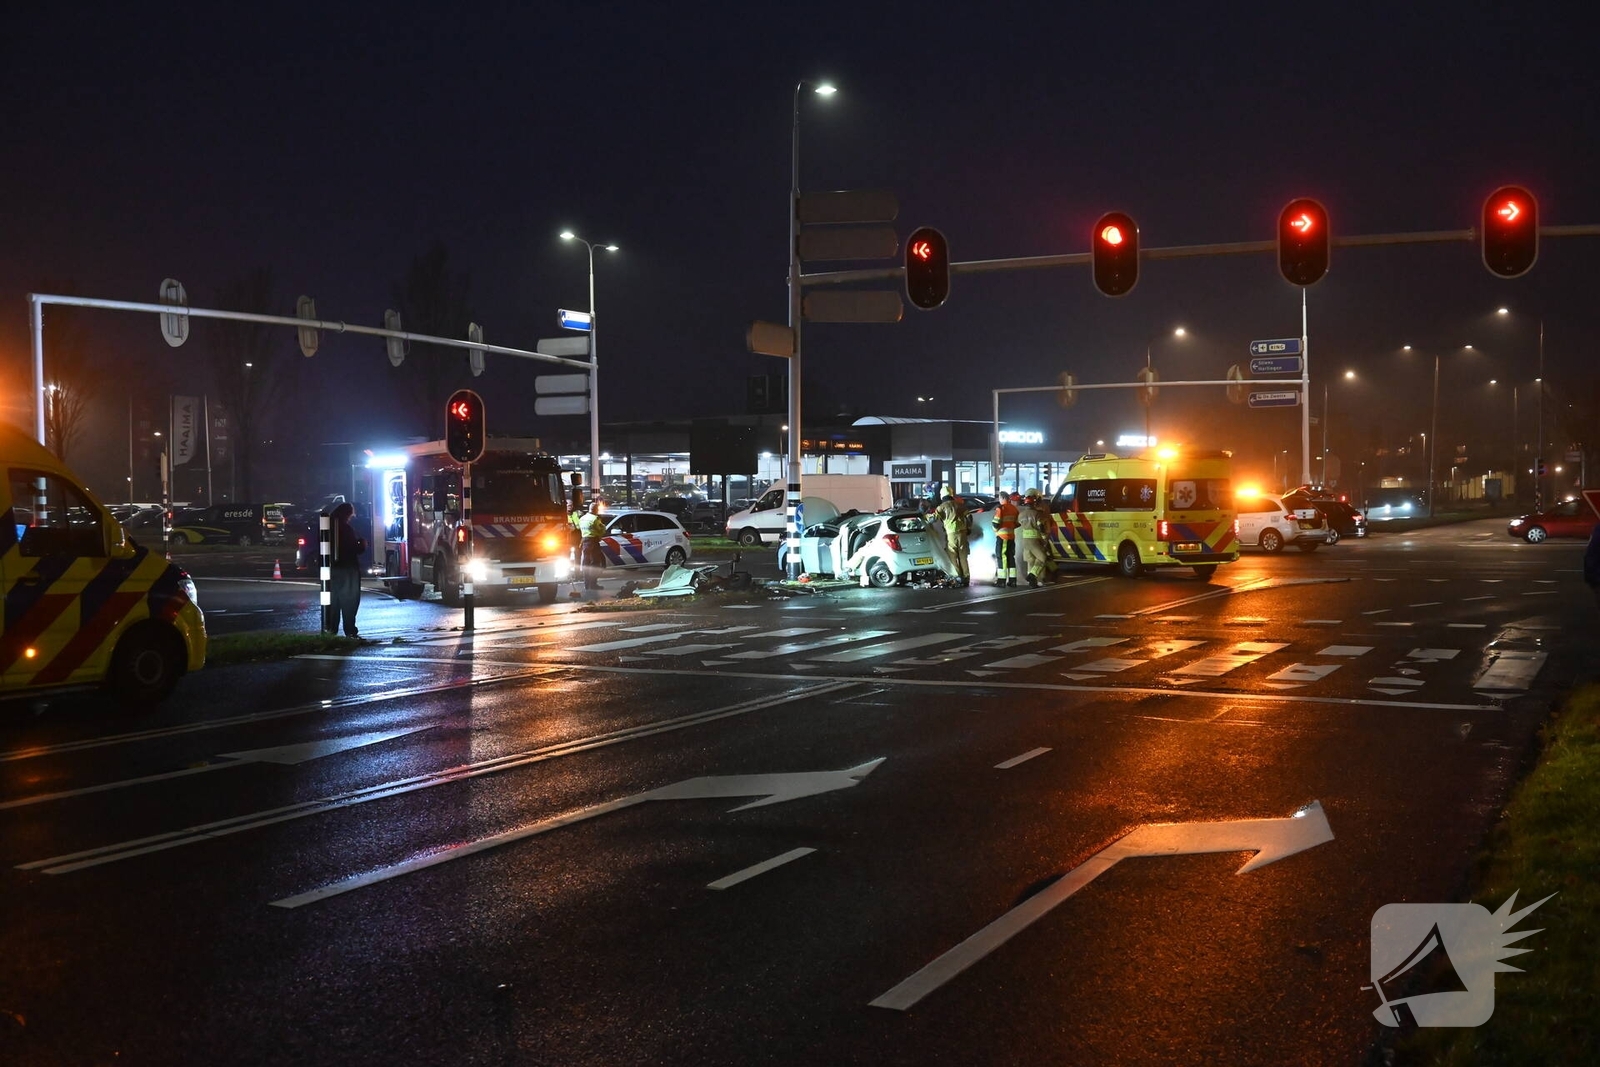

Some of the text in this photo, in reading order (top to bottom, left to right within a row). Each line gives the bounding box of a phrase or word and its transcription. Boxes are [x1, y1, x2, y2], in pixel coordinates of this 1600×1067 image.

[179, 404, 192, 457] HAAIMA
[894, 467, 923, 475] HAAIMA
[224, 508, 254, 518] eresdé
[493, 515, 546, 524] BRANDWEER
